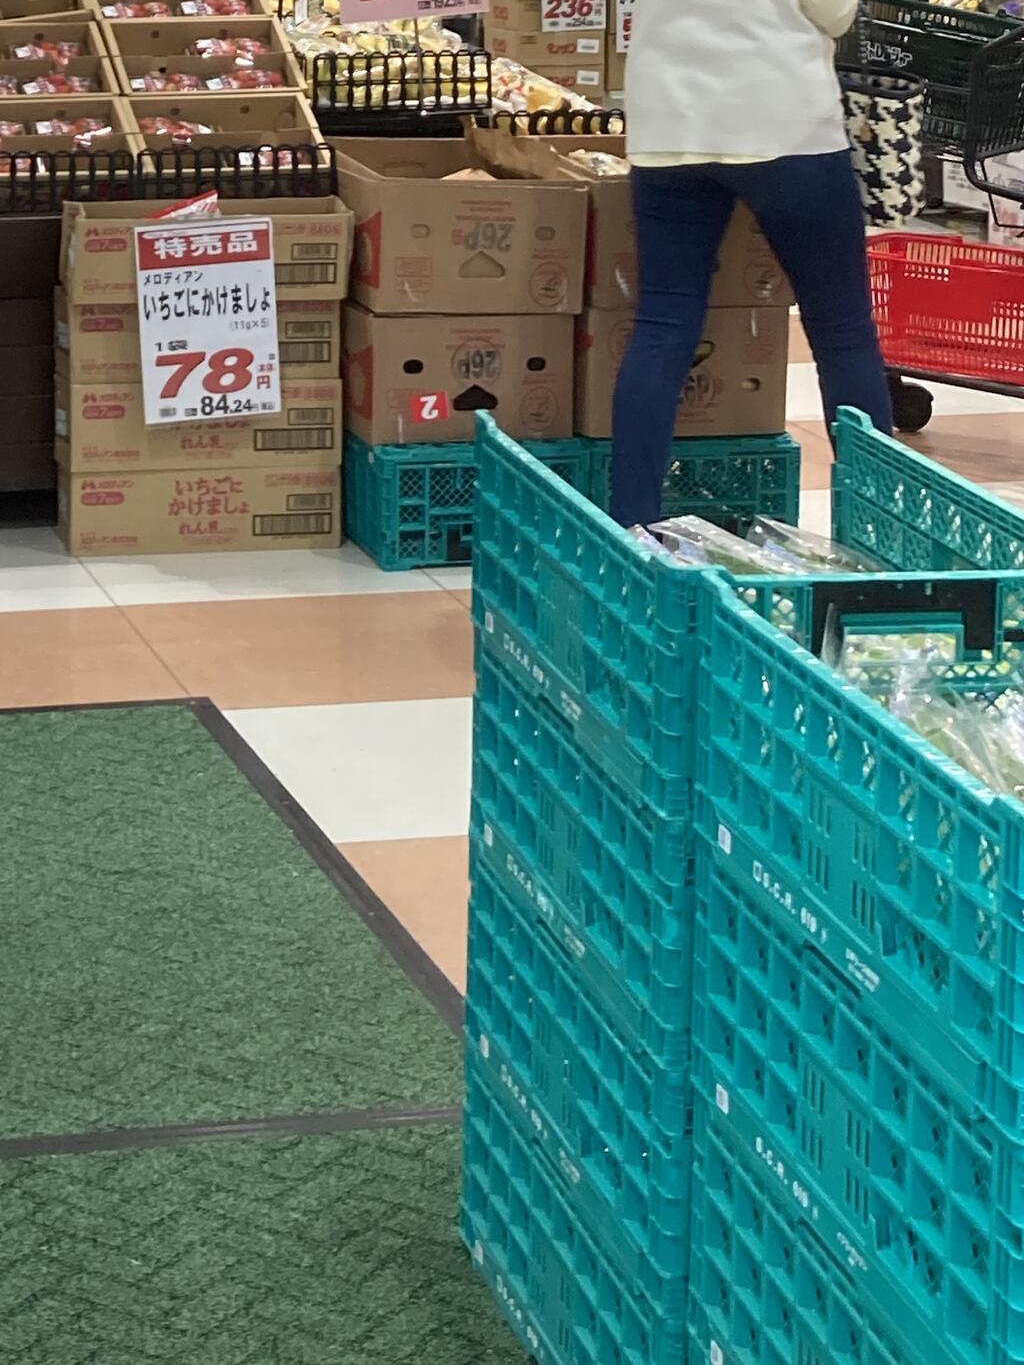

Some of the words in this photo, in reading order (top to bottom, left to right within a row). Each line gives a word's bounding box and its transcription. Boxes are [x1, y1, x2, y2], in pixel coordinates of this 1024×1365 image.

[153, 231, 259, 260] 特売品
[143, 270, 204, 286] メロディアン
[143, 283, 271, 321] いちごにかけましょ
[154, 347, 255, 400] 78
[256, 375, 271, 390] 円
[419, 394, 439, 420] 2
[175, 475, 244, 496] いちごに
[167, 495, 251, 516] かけましょ
